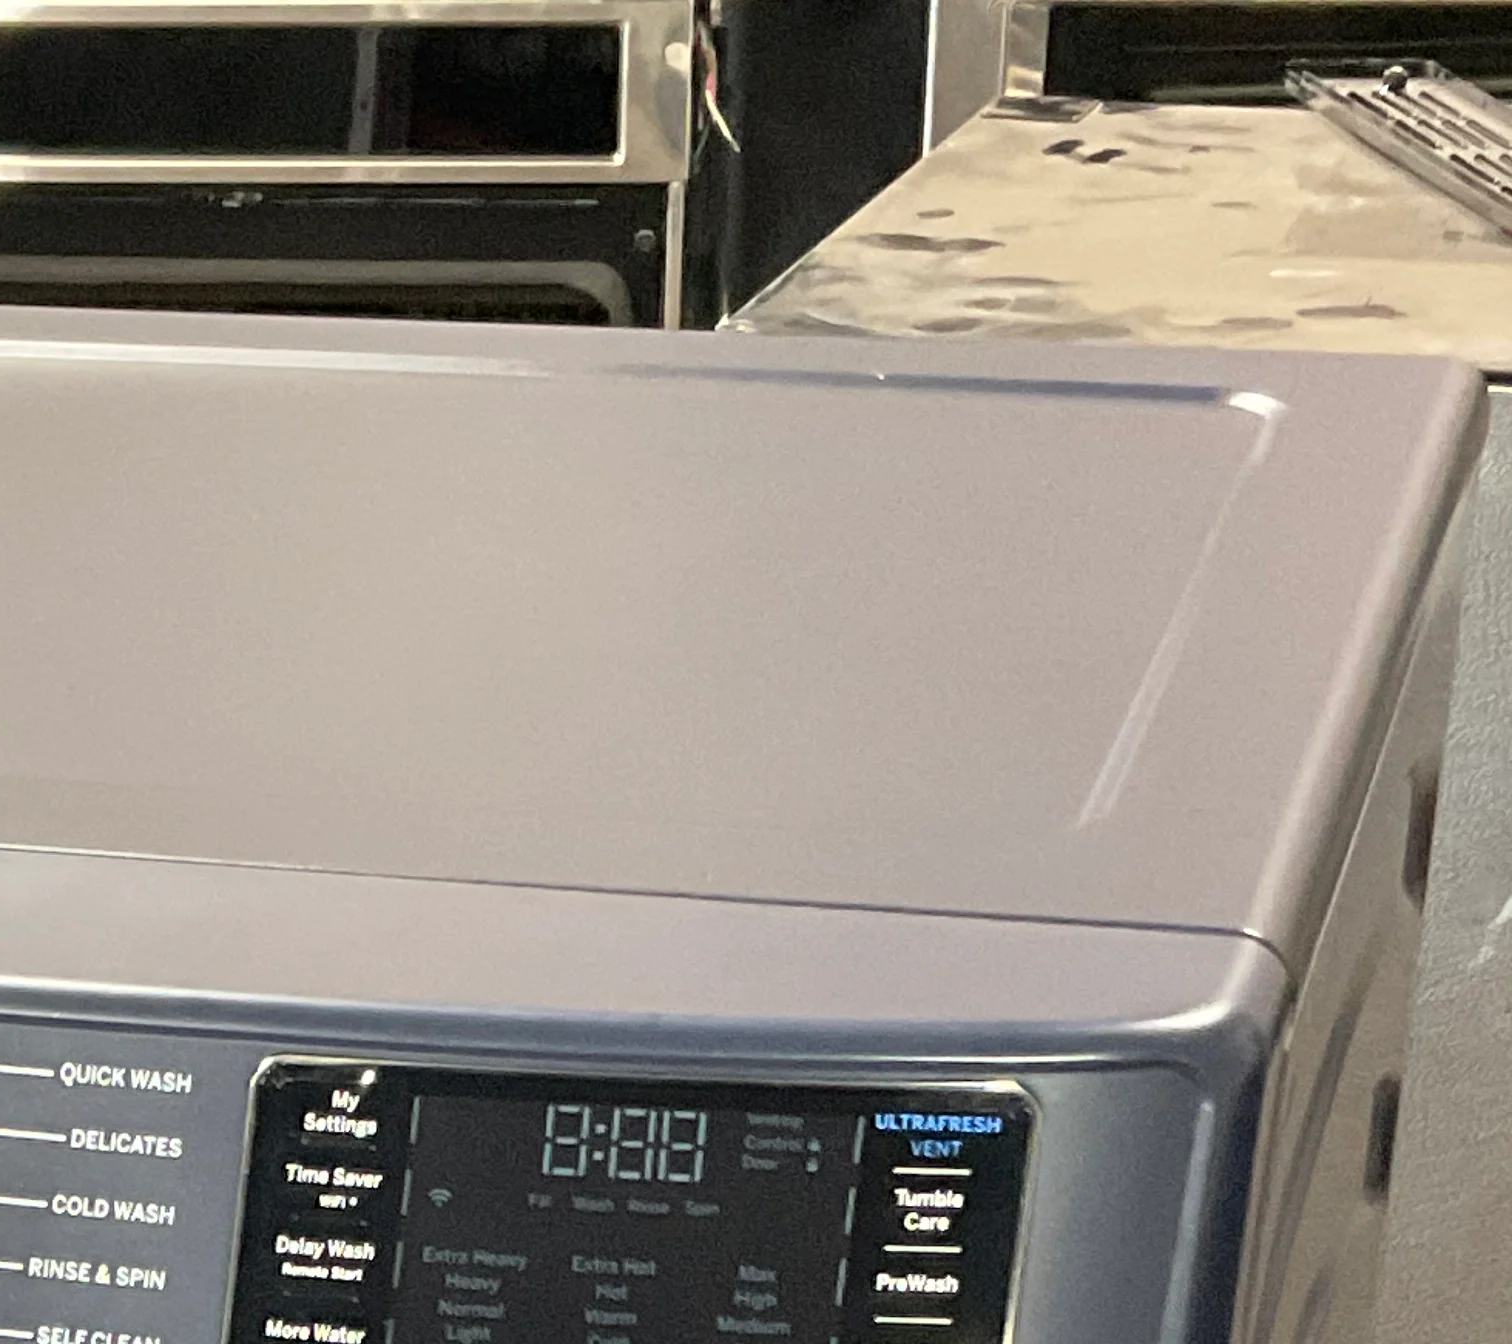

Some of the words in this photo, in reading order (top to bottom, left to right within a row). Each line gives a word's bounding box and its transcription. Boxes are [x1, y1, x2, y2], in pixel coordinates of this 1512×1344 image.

[59, 1061, 126, 1089] QUICK
[130, 1067, 193, 1094] WASH
[331, 1089, 360, 1113] My
[303, 1112, 378, 1139] Settings
[874, 1112, 1003, 1135] ULTRAFRESH
[69, 1127, 183, 1159] DELICATES
[541, 1103, 708, 1183] 8:88
[908, 1139, 964, 1158] VENT
[285, 1163, 330, 1187] Time
[333, 1166, 384, 1190] Saver
[51, 1193, 110, 1219] COLD
[113, 1200, 176, 1226] WASH
[894, 1188, 965, 1209] Tumble
[903, 1212, 950, 1231] Care
[275, 1234, 326, 1261] Delay
[327, 1238, 376, 1262] Wash
[27, 1256, 92, 1283] RINSE
[94, 1264, 112, 1285] &
[115, 1265, 167, 1291] SPIN
[875, 1272, 959, 1294] PreWash
[264, 1319, 310, 1341] More
